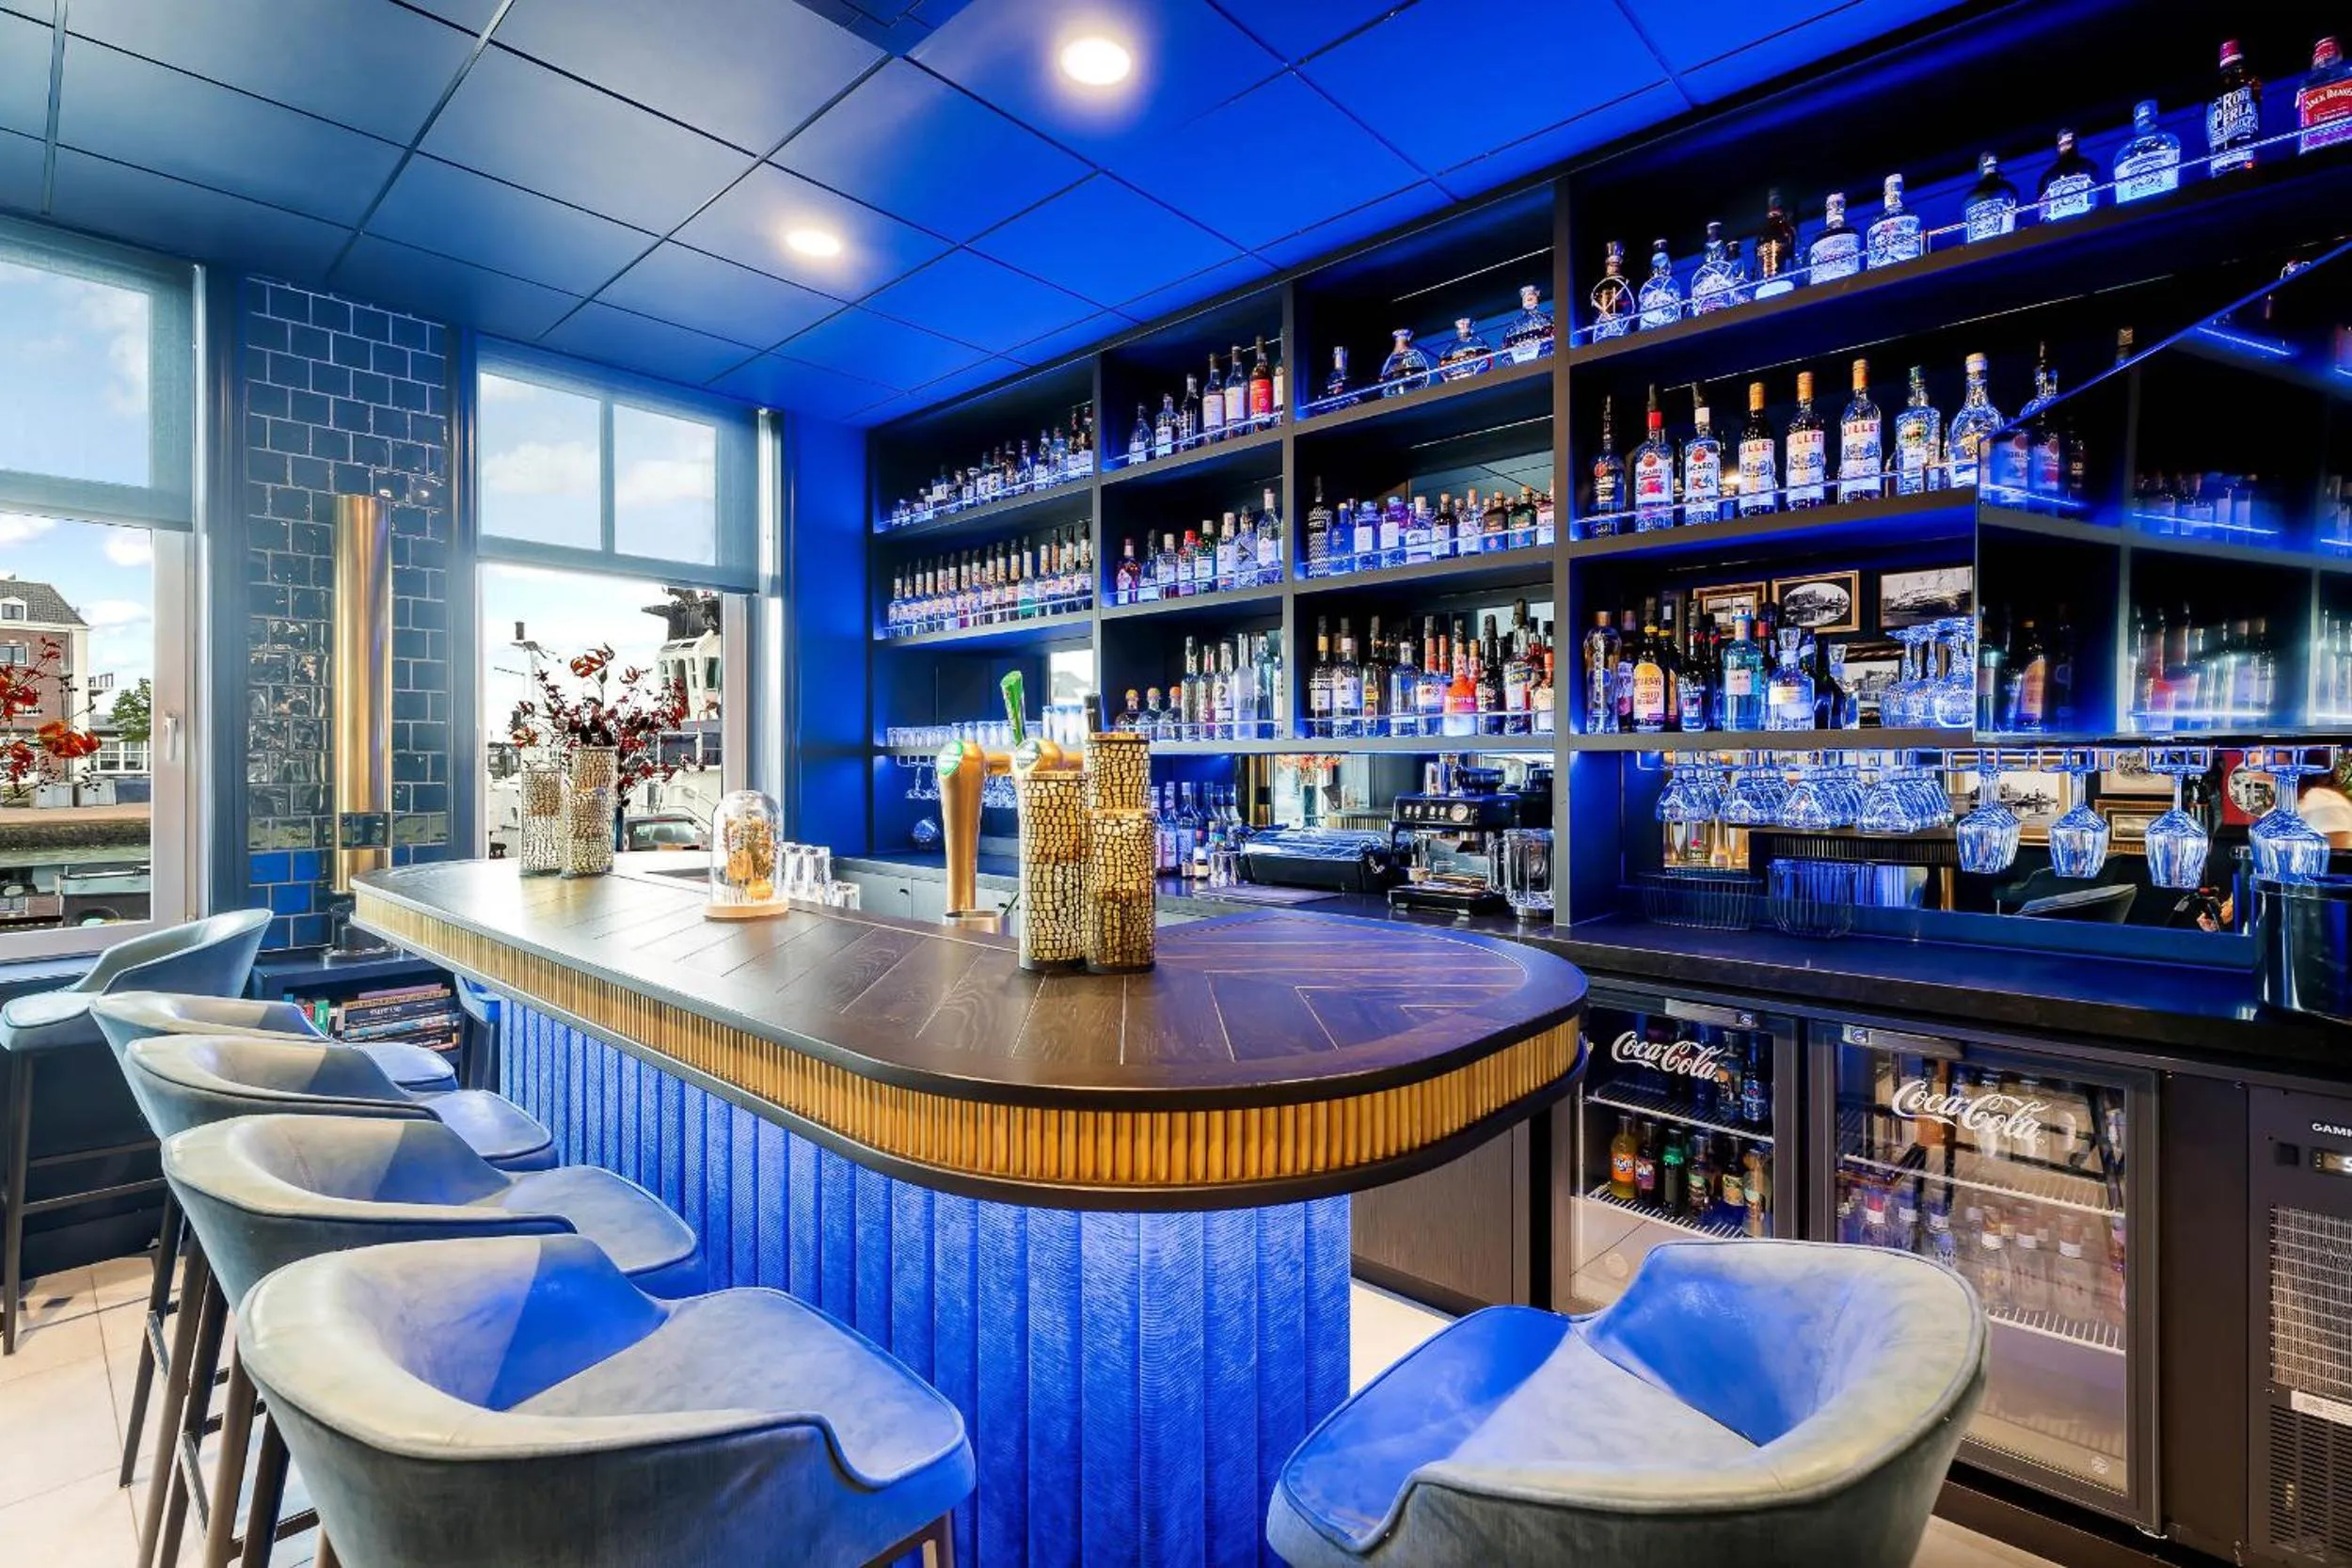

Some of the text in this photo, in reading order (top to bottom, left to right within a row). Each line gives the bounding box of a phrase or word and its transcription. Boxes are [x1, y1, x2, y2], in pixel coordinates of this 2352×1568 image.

[2215, 103, 2252, 129] PERLA
[1612, 1031, 1725, 1080] Coca-Cola
[1892, 1080, 2053, 1141] Coca-Cola
